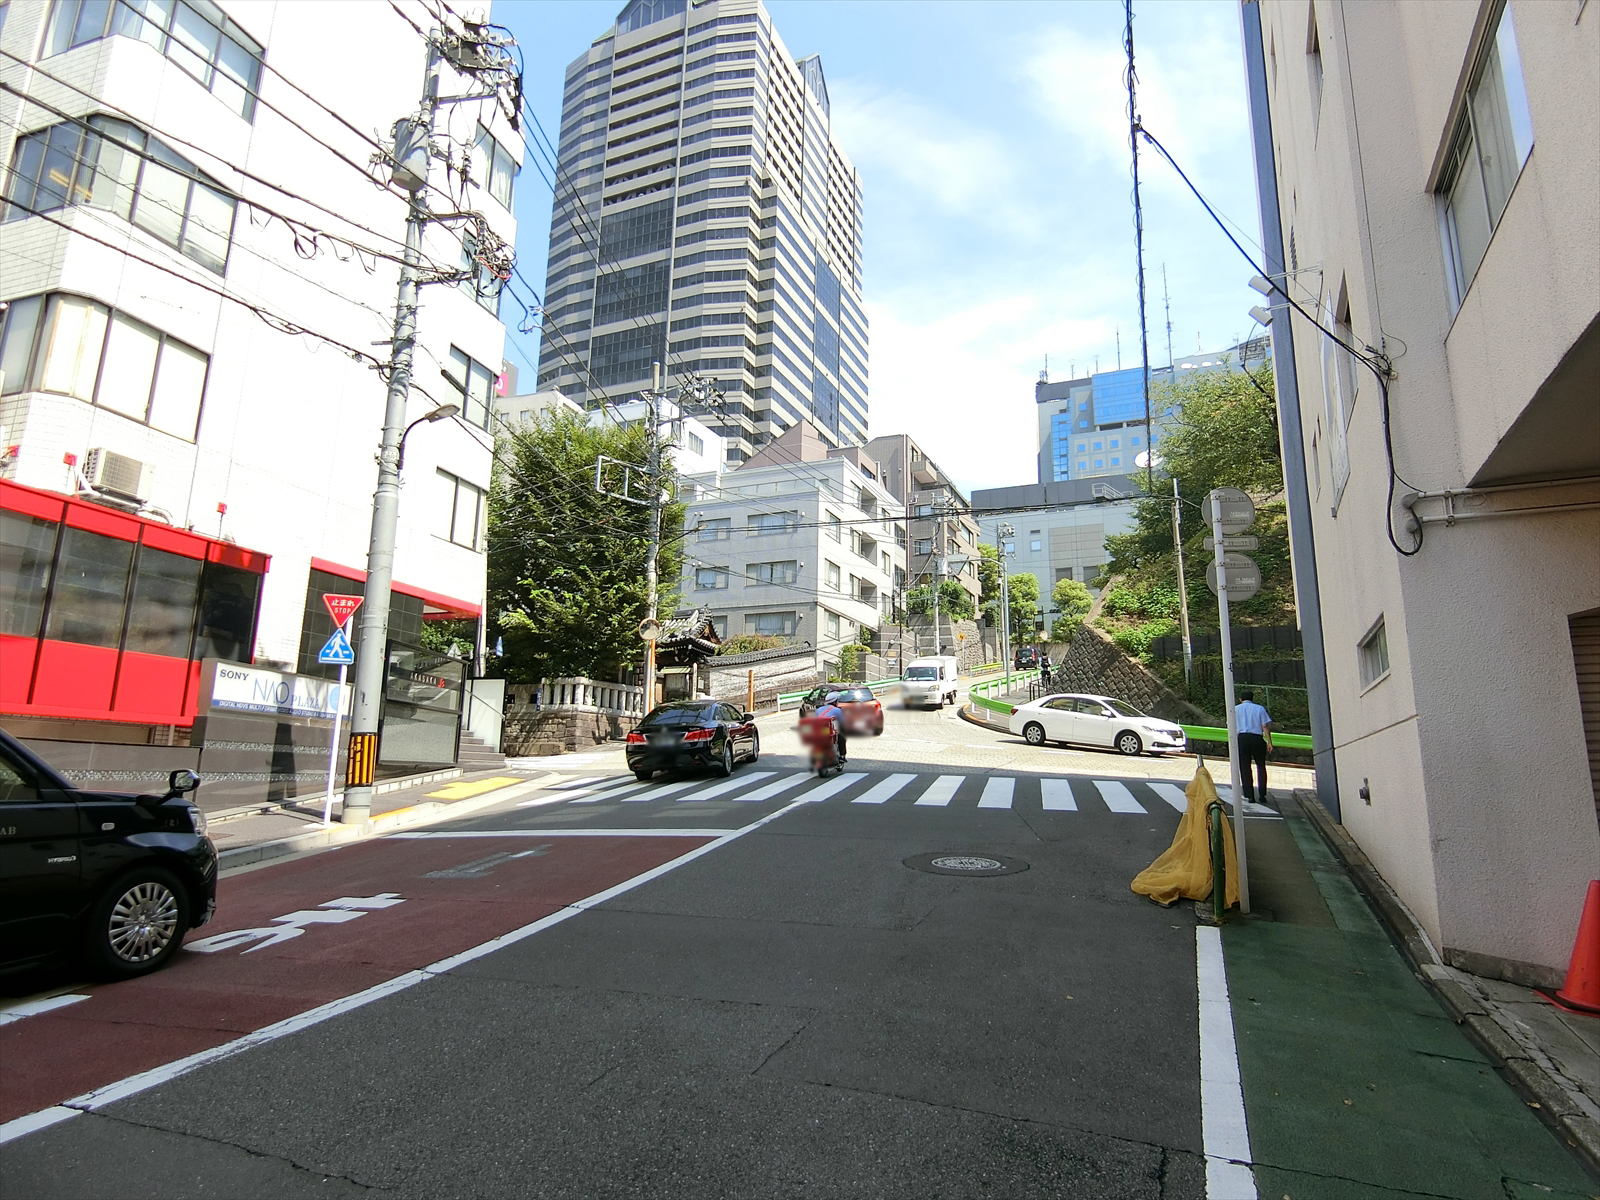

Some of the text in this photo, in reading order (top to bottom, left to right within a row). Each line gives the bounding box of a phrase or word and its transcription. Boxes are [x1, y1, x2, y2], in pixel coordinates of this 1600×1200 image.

[331, 598, 355, 607] 止まれ
[220, 669, 249, 681] SONY
[410, 672, 437, 685] AKASAKA
[219, 700, 236, 708] DIGITAL
[290, 694, 320, 709] PLAZA
